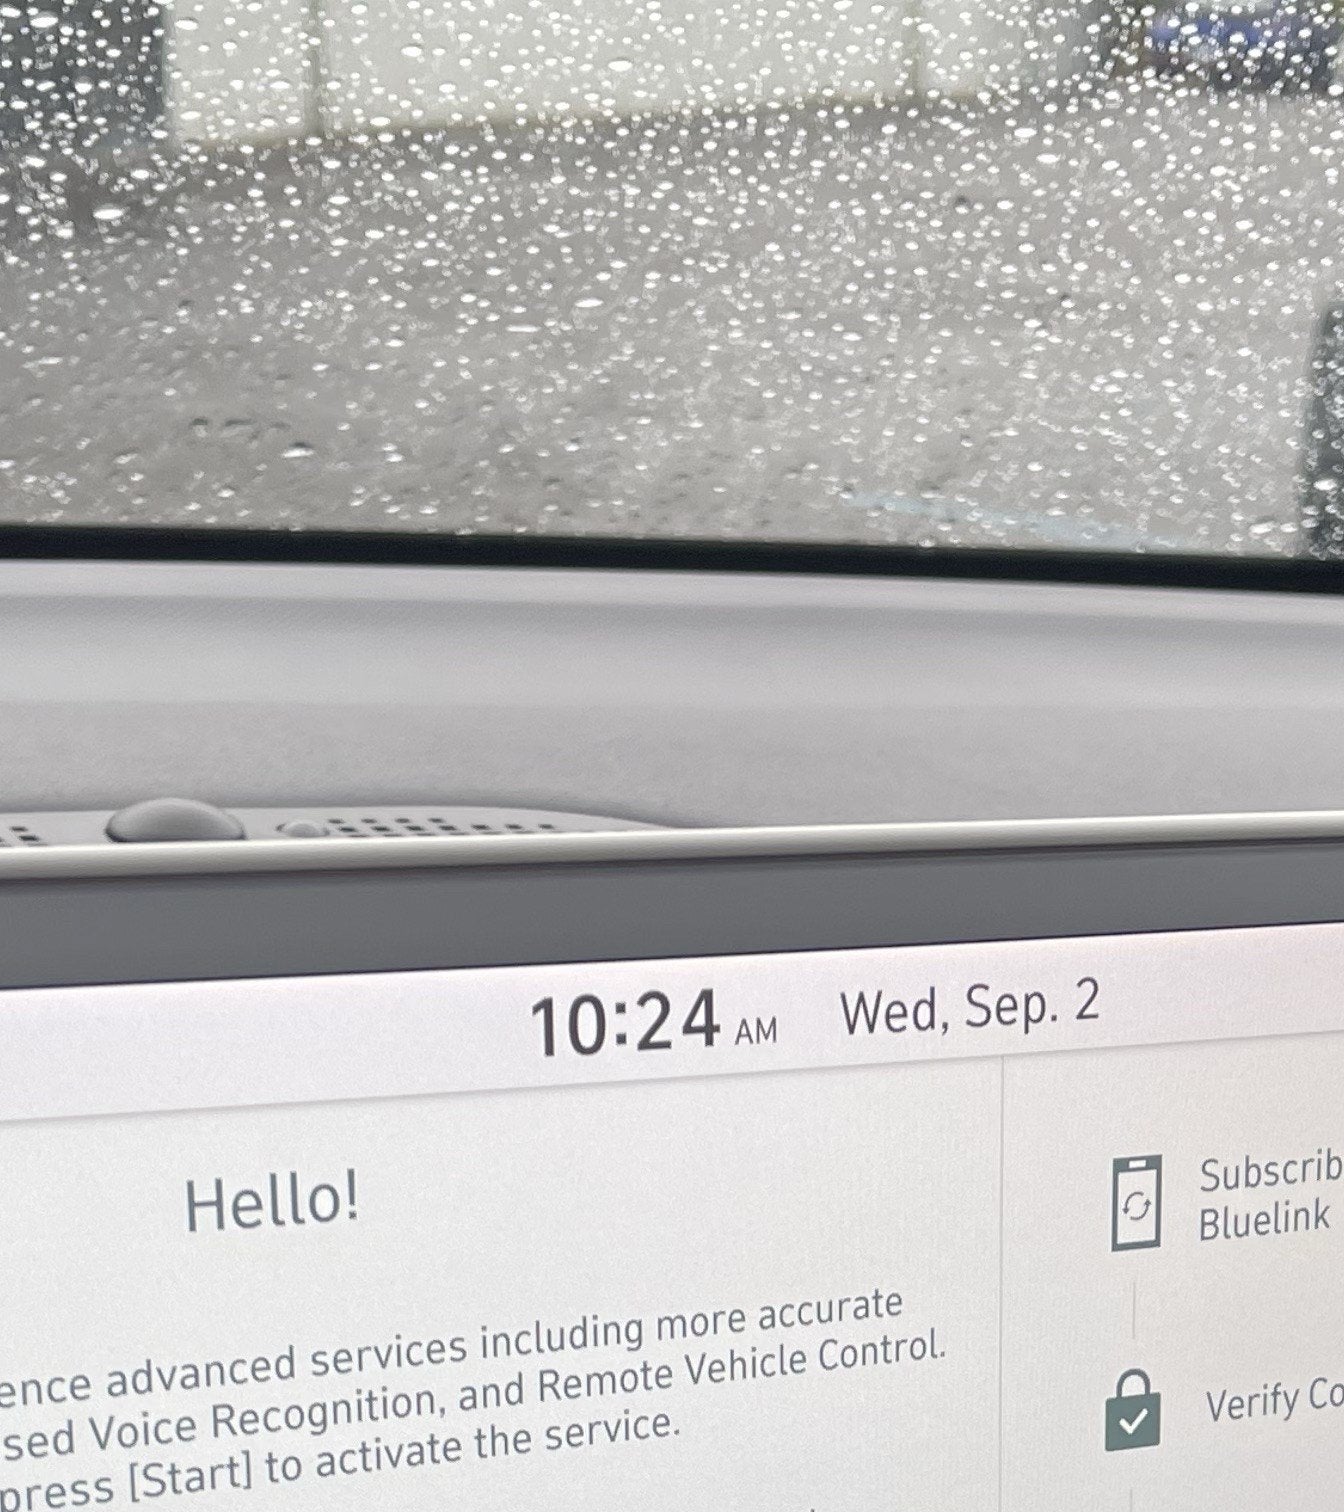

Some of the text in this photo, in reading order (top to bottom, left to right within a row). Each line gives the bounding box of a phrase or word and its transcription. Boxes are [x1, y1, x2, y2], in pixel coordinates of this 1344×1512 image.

[531, 987, 778, 1058] 10:24 AM
[839, 975, 1100, 1036] Wed, Sep. 2
[185, 1167, 358, 1233] Hello!
[1199, 1196, 1331, 1242] Bluelink
[106, 1344, 296, 1399] advanced
[310, 1333, 468, 1378] services
[480, 1313, 644, 1359] including
[656, 1308, 747, 1341] more
[758, 1288, 903, 1331] accurate
[87, 1410, 197, 1451] Voice
[211, 1385, 446, 1439] Recognition,
[458, 1370, 524, 1412] and
[538, 1360, 674, 1403] Remote
[683, 1343, 807, 1386] Vehicle
[818, 1326, 946, 1372] Control.
[1205, 1381, 1300, 1423] Verify
[128, 1449, 253, 1504] [Start]
[264, 1451, 303, 1484] to
[315, 1432, 463, 1479] activate
[473, 1423, 532, 1460] the
[545, 1408, 681, 1452] service.
